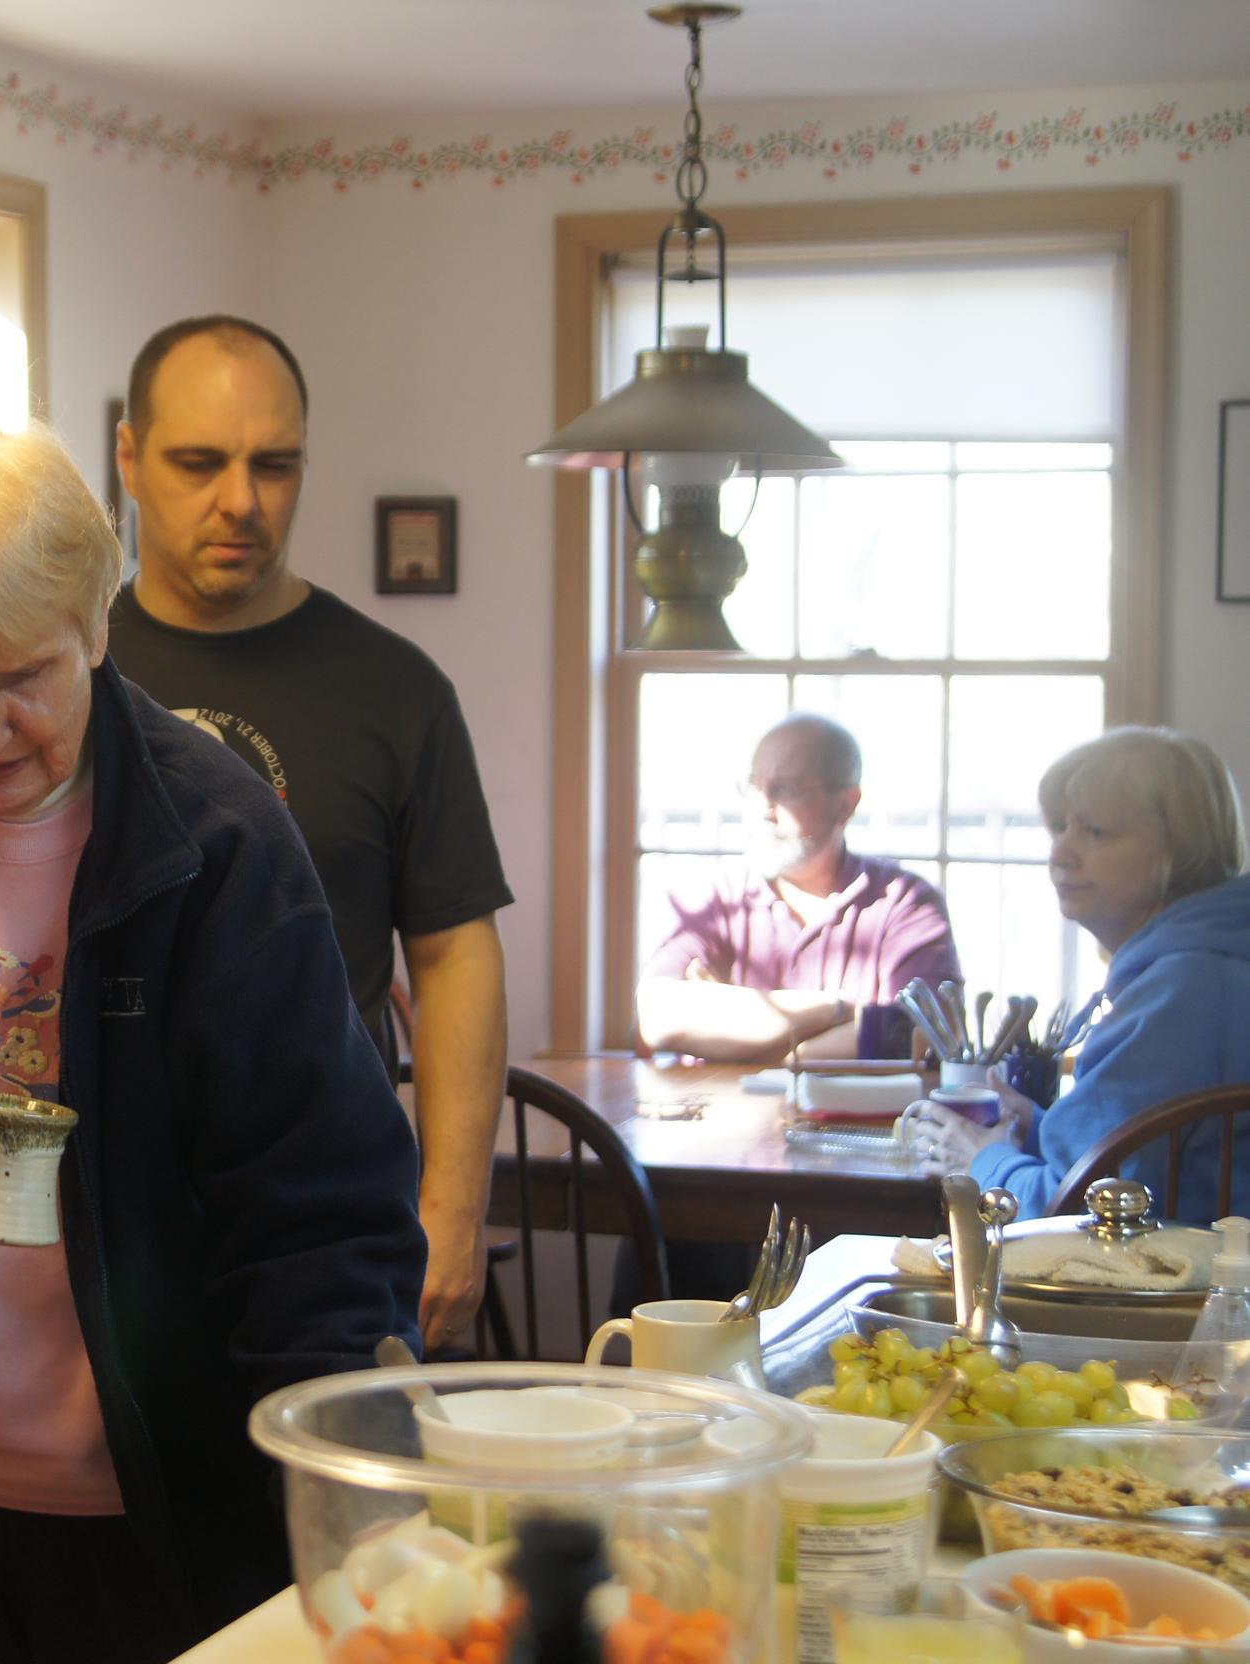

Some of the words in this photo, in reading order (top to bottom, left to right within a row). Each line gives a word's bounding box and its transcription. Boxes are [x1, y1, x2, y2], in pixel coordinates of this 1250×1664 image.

[198, 708, 234, 726] 2012
[235, 717, 255, 737] 21,
[249, 731, 287, 789] OCTOBER
